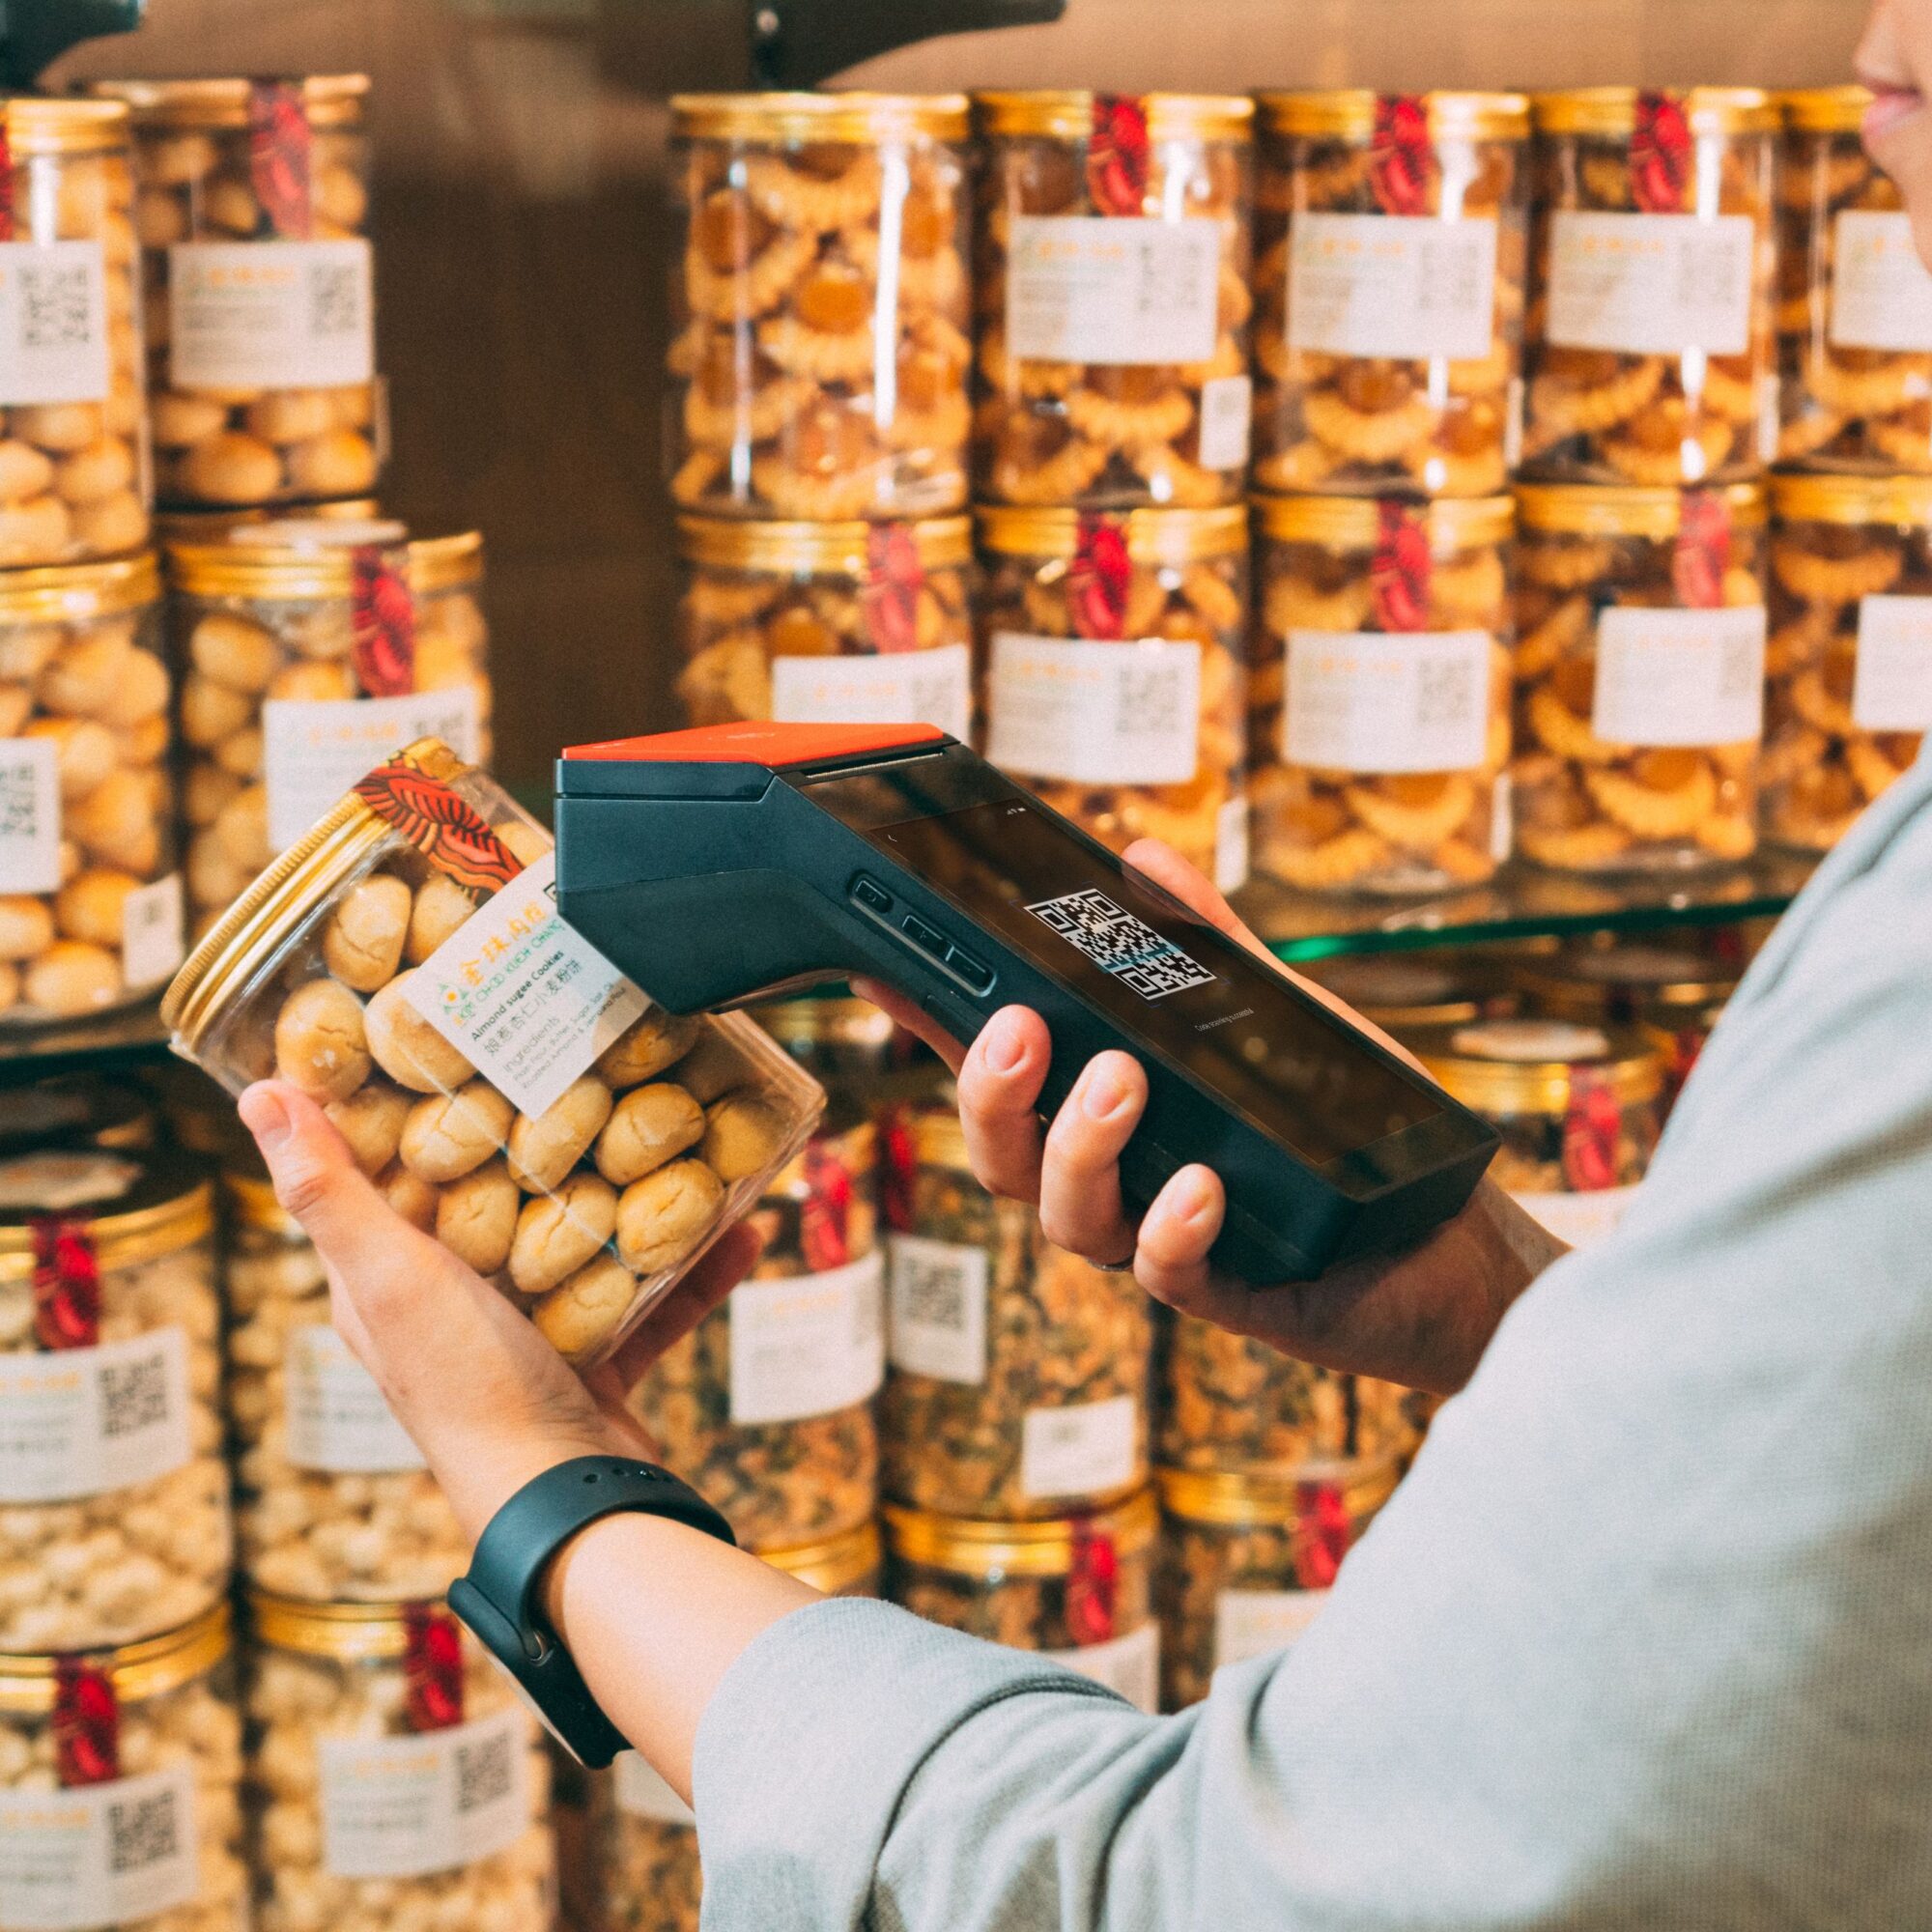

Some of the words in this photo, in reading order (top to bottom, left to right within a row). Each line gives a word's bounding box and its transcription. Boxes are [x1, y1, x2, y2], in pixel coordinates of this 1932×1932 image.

[471, 1005, 507, 1041] Almond
[506, 978, 533, 1008] sugee
[531, 950, 565, 980] Cookies
